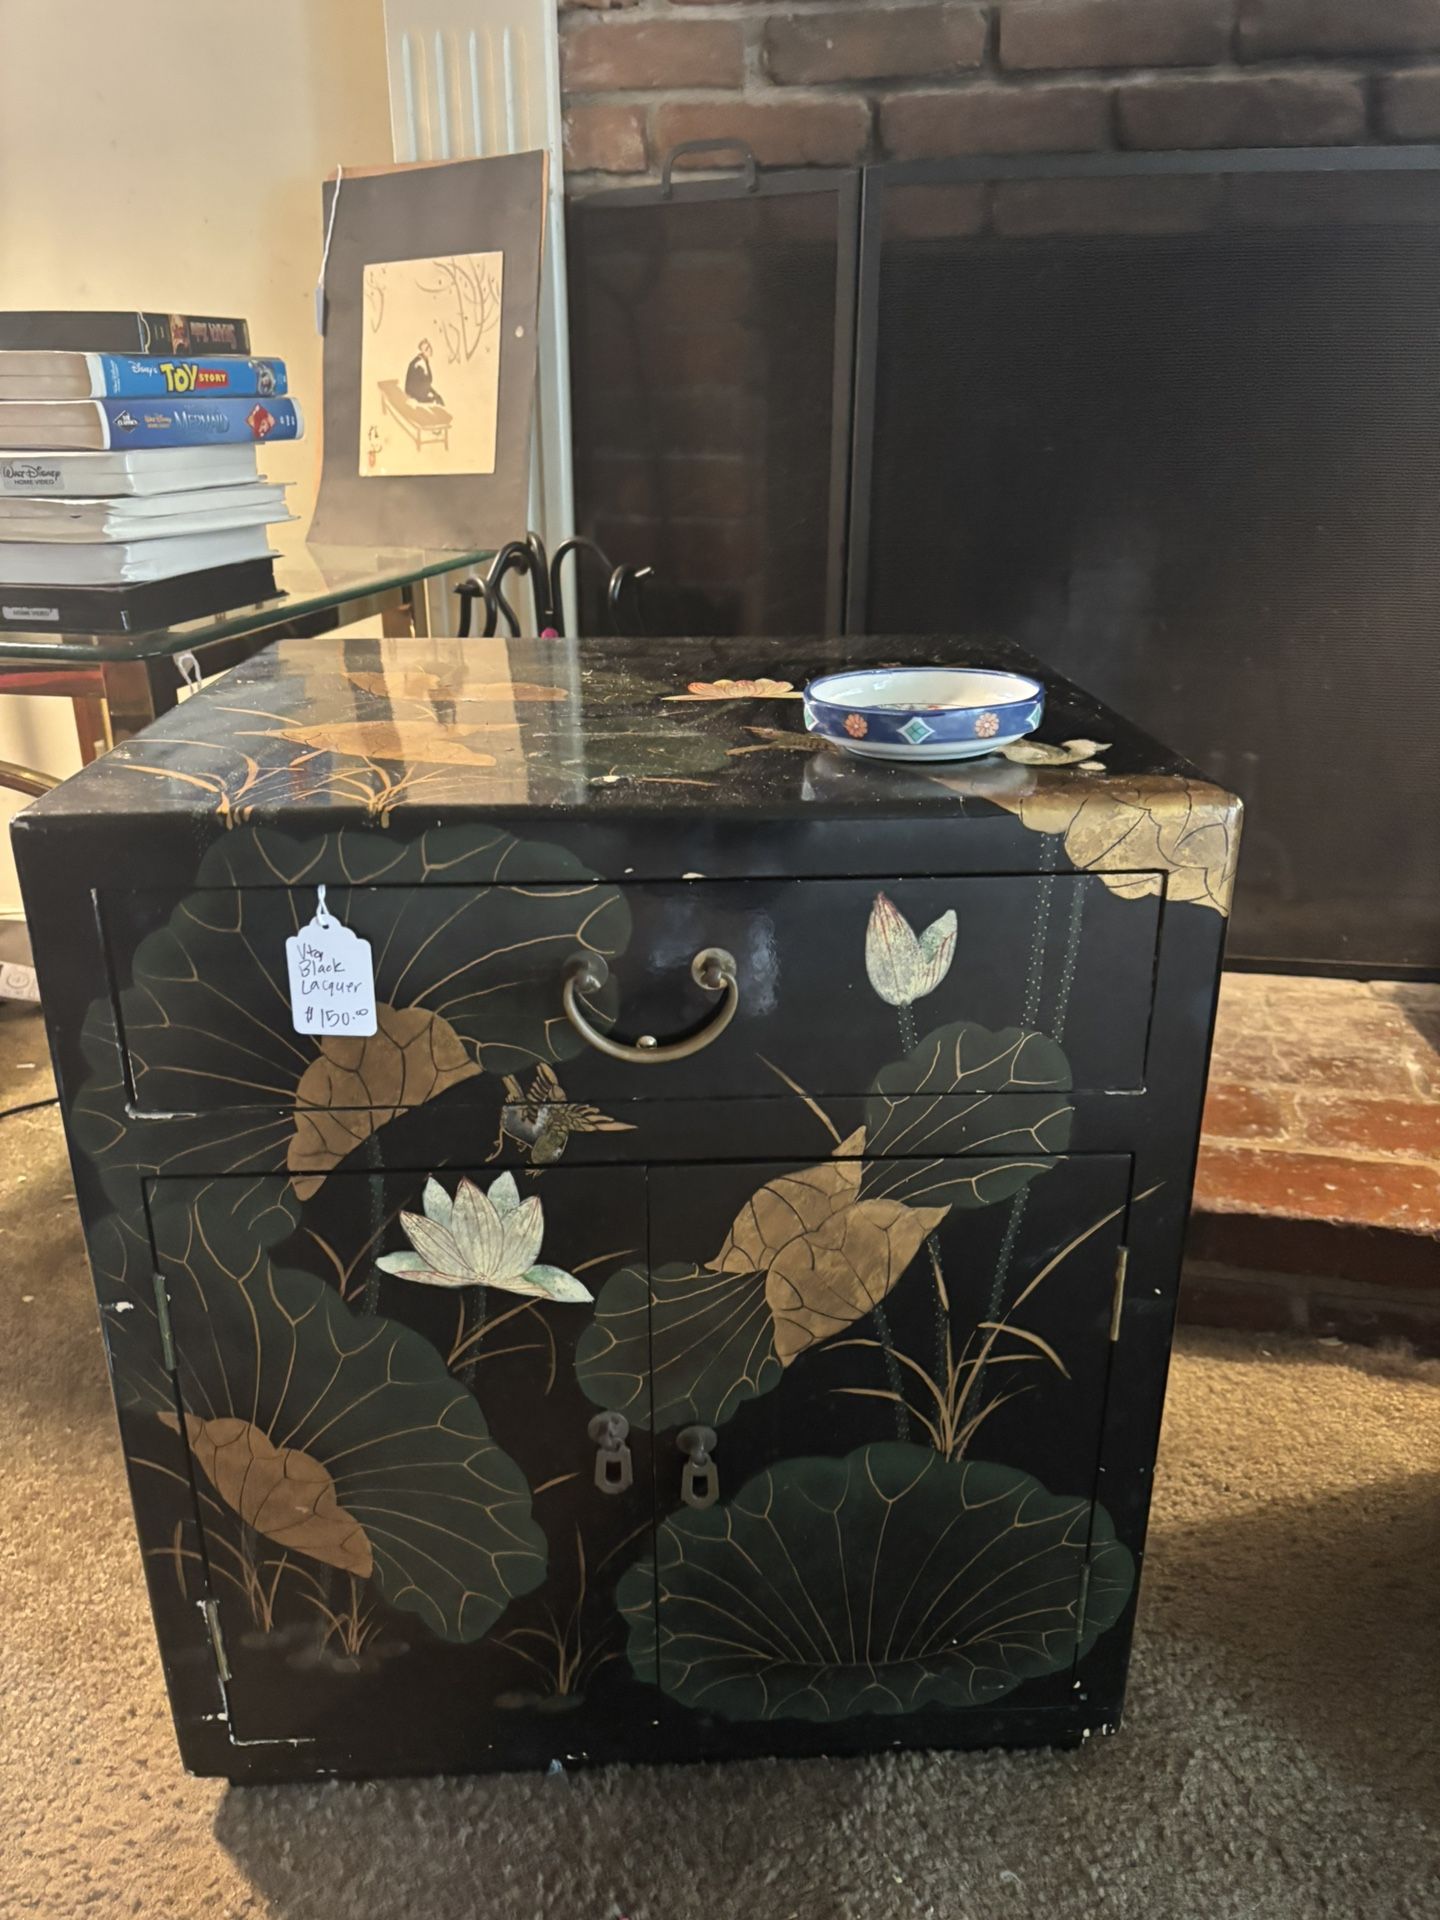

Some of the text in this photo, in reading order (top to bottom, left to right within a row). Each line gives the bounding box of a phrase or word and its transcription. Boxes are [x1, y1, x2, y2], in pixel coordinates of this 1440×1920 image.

[160, 363, 198, 392] TOY
[199, 373, 227, 383] STORY
[299, 958, 345, 977] Black
[302, 980, 362, 996] Lacquer
